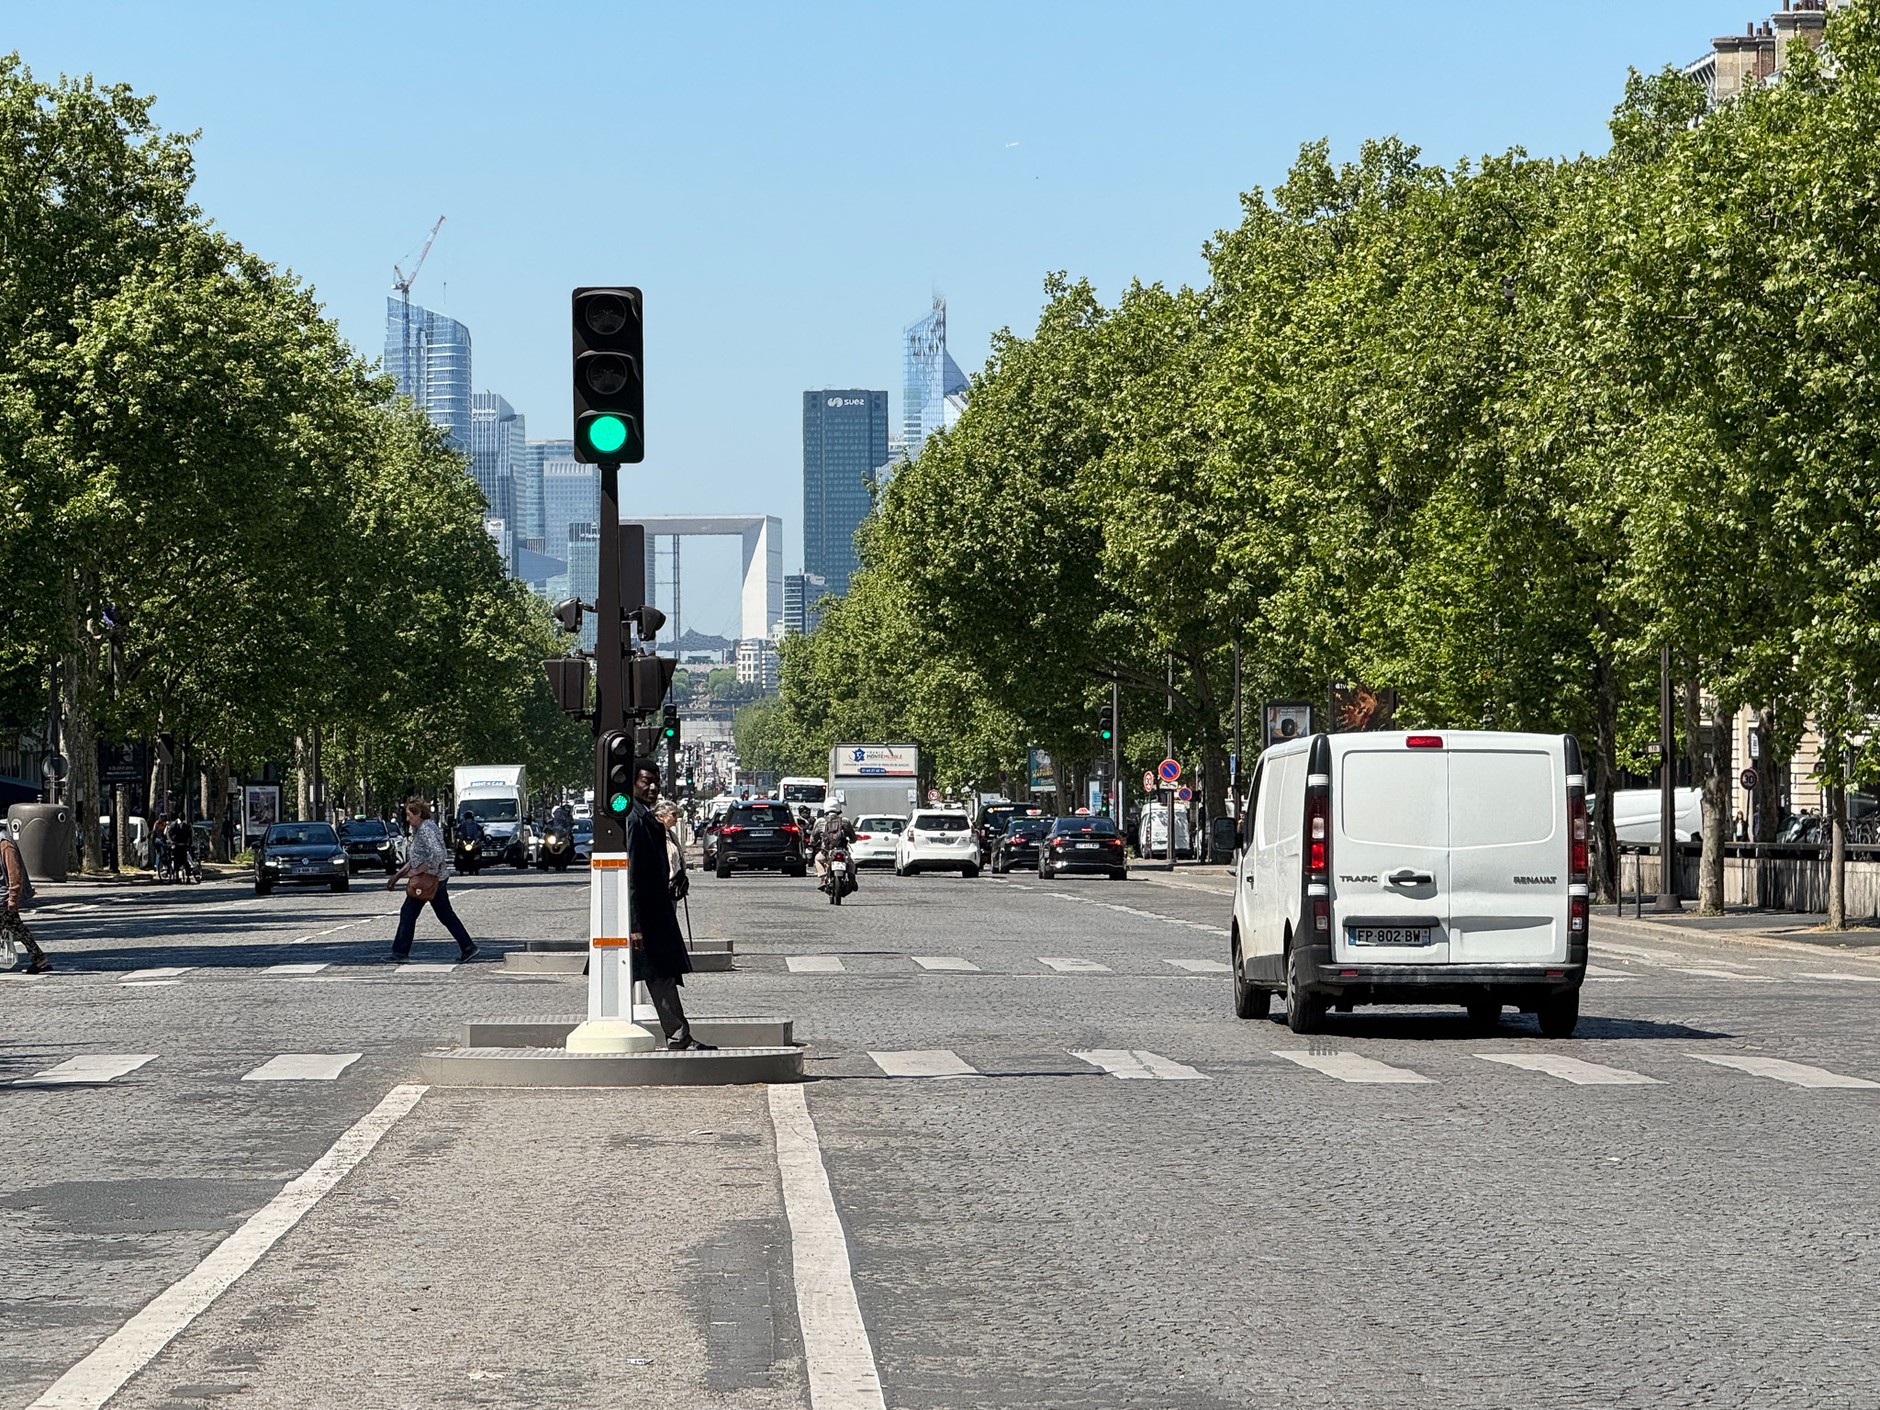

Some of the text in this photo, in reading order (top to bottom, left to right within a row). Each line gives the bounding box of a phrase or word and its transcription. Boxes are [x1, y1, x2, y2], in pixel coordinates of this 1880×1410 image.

[843, 398, 865, 406] suez
[1744, 774, 1754, 784] 30
[1339, 875, 1378, 883] TRAFIC
[1513, 876, 1558, 885] RENAULT
[1357, 929, 1421, 942] FP-802-BW
